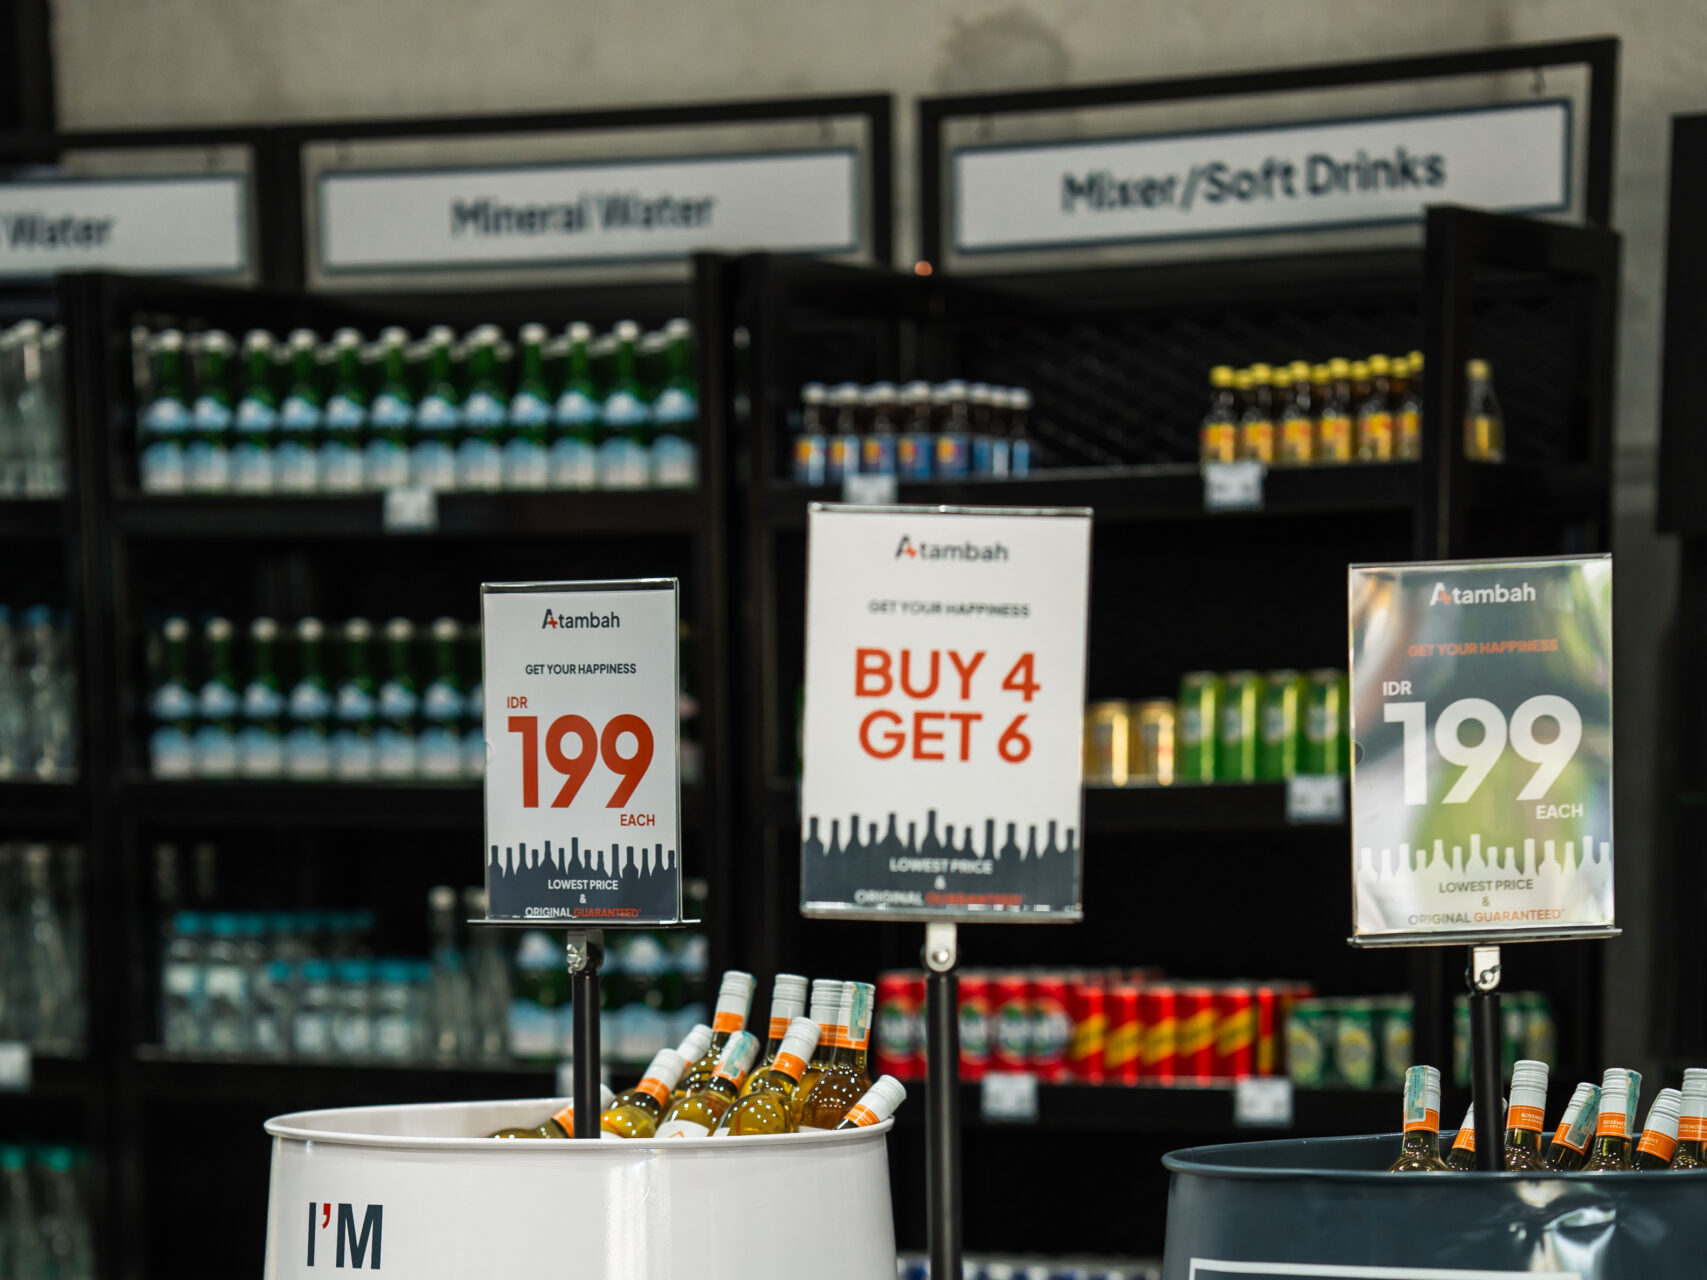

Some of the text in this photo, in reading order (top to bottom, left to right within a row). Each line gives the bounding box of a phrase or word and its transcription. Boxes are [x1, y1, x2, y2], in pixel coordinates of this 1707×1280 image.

[1061, 145, 1447, 214] Mixer/Soft Drinks
[451, 191, 717, 238] Mineral Water
[895, 534, 1009, 562] Atambah
[1429, 582, 1536, 606] Atambah
[868, 599, 1031, 617] GET YOUR HAPPINESS
[541, 609, 621, 629] Atambah
[1408, 639, 1558, 657] GET YOUR HAPPINESS
[525, 663, 637, 675] GET YOUR HAPPINESS
[854, 647, 1041, 702] BUY 4
[1382, 681, 1412, 697] IDR
[507, 696, 528, 709] IDR
[858, 709, 1032, 764] GET 6
[1383, 694, 1583, 806] 199
[508, 714, 654, 808] 199
[620, 814, 655, 827] EACH
[1536, 803, 1584, 820] EACH
[889, 857, 994, 875] LOWEST PRICE
[548, 879, 619, 890] LOWEST PRICE
[1438, 879, 1534, 894] LOWEST PRICE
[579, 893, 587, 904] &
[1481, 897, 1490, 907] &
[525, 907, 572, 918] ORIGINAL
[1408, 912, 1472, 926] ORIGINAL
